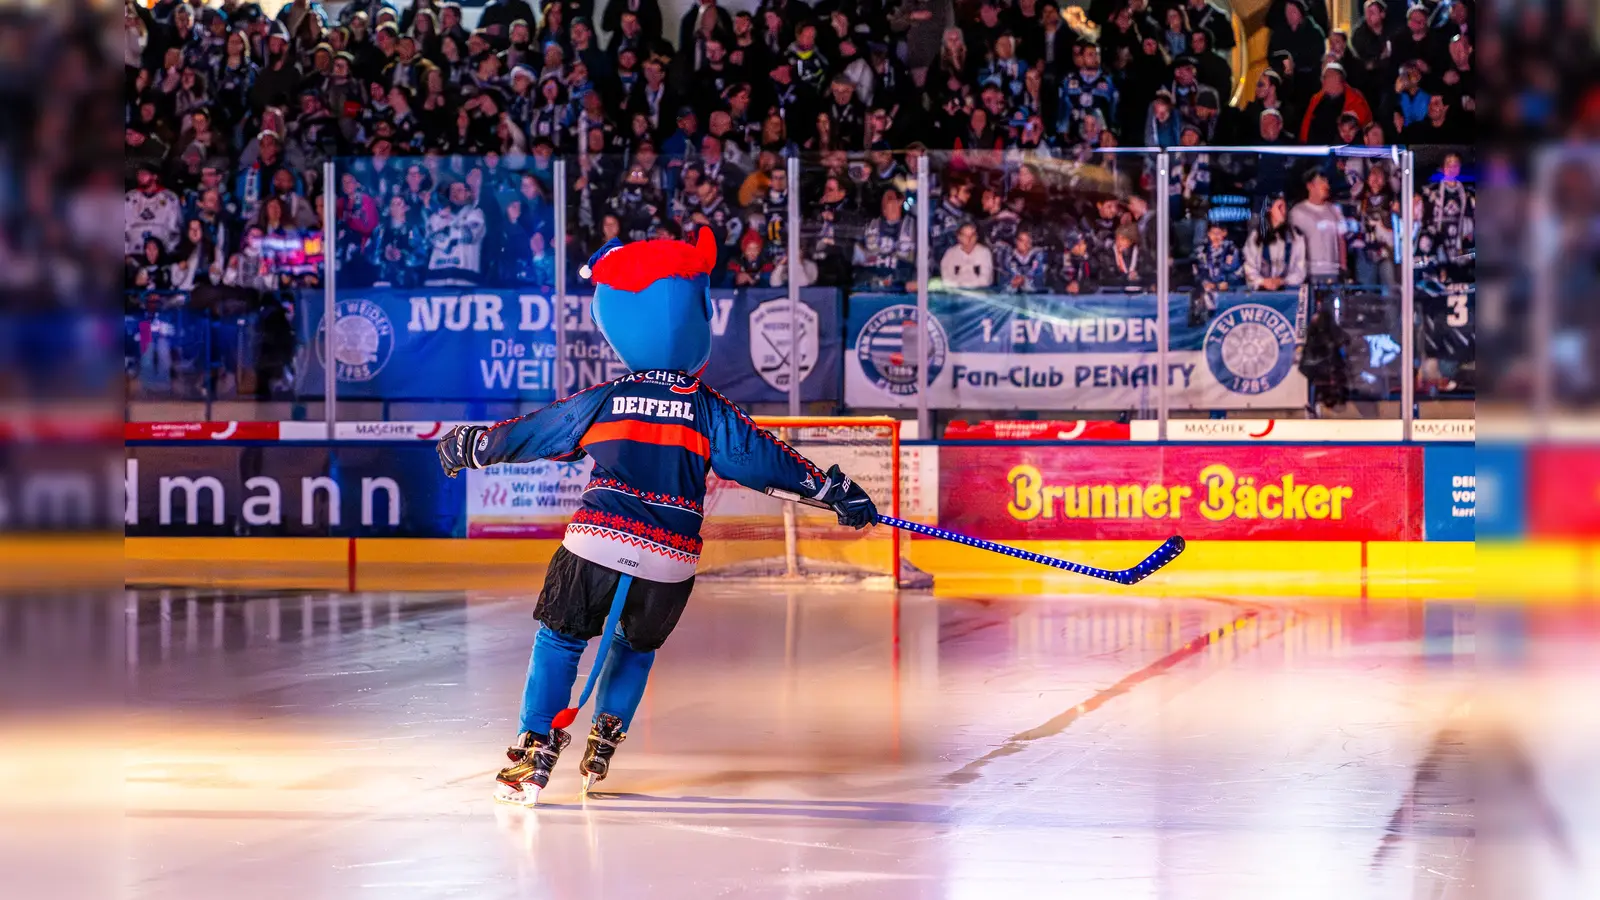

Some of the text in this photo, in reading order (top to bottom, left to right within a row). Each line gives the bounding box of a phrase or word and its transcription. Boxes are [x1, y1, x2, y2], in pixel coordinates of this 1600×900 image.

[407, 295, 504, 331] NUR
[518, 294, 596, 331] DE
[1446, 293, 1469, 327] 3
[981, 317, 1159, 343] 1. EV WEIDEN
[1240, 308, 1293, 345] WEIDEN
[491, 338, 525, 358] Die
[480, 359, 628, 390] WEIDNE
[952, 365, 1063, 389] Fan-Club
[612, 396, 695, 421] DEIFERL
[356, 424, 414, 434] MASCHEK
[1184, 423, 1246, 434] MASCHEK
[511, 480, 582, 494] Wir liefern
[1006, 463, 1353, 521] Brunner Bäcker
[512, 495, 532, 508] die
